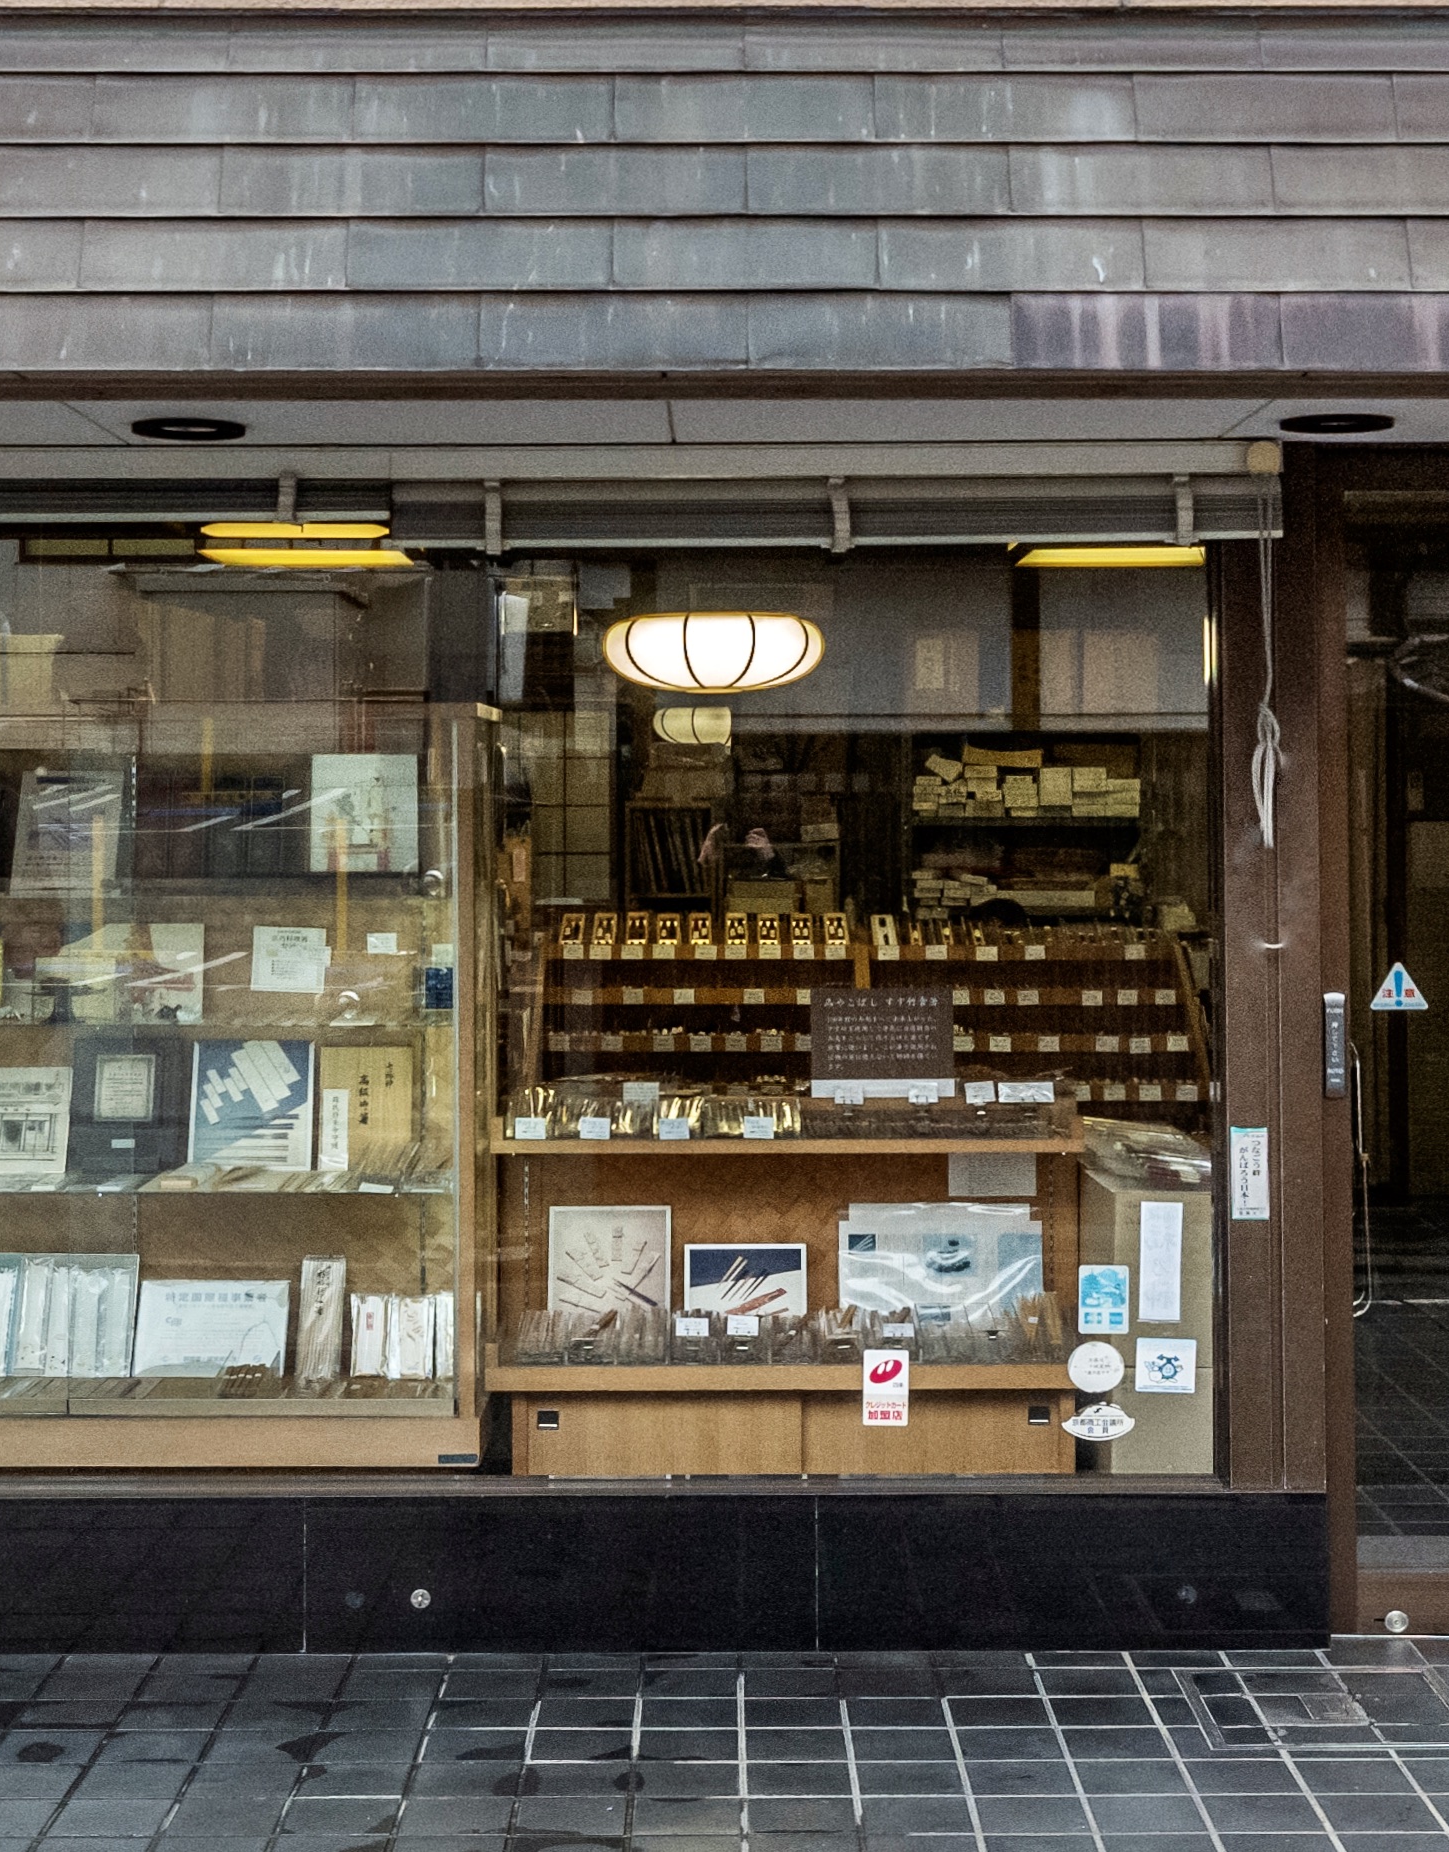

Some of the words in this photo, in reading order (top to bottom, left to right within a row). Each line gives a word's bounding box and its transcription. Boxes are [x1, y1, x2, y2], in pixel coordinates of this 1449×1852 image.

[865, 1400, 907, 1409] クレジットカード
[867, 1410, 903, 1421] 加盟店
[1071, 1418, 1124, 1427] 京都商工会議所
